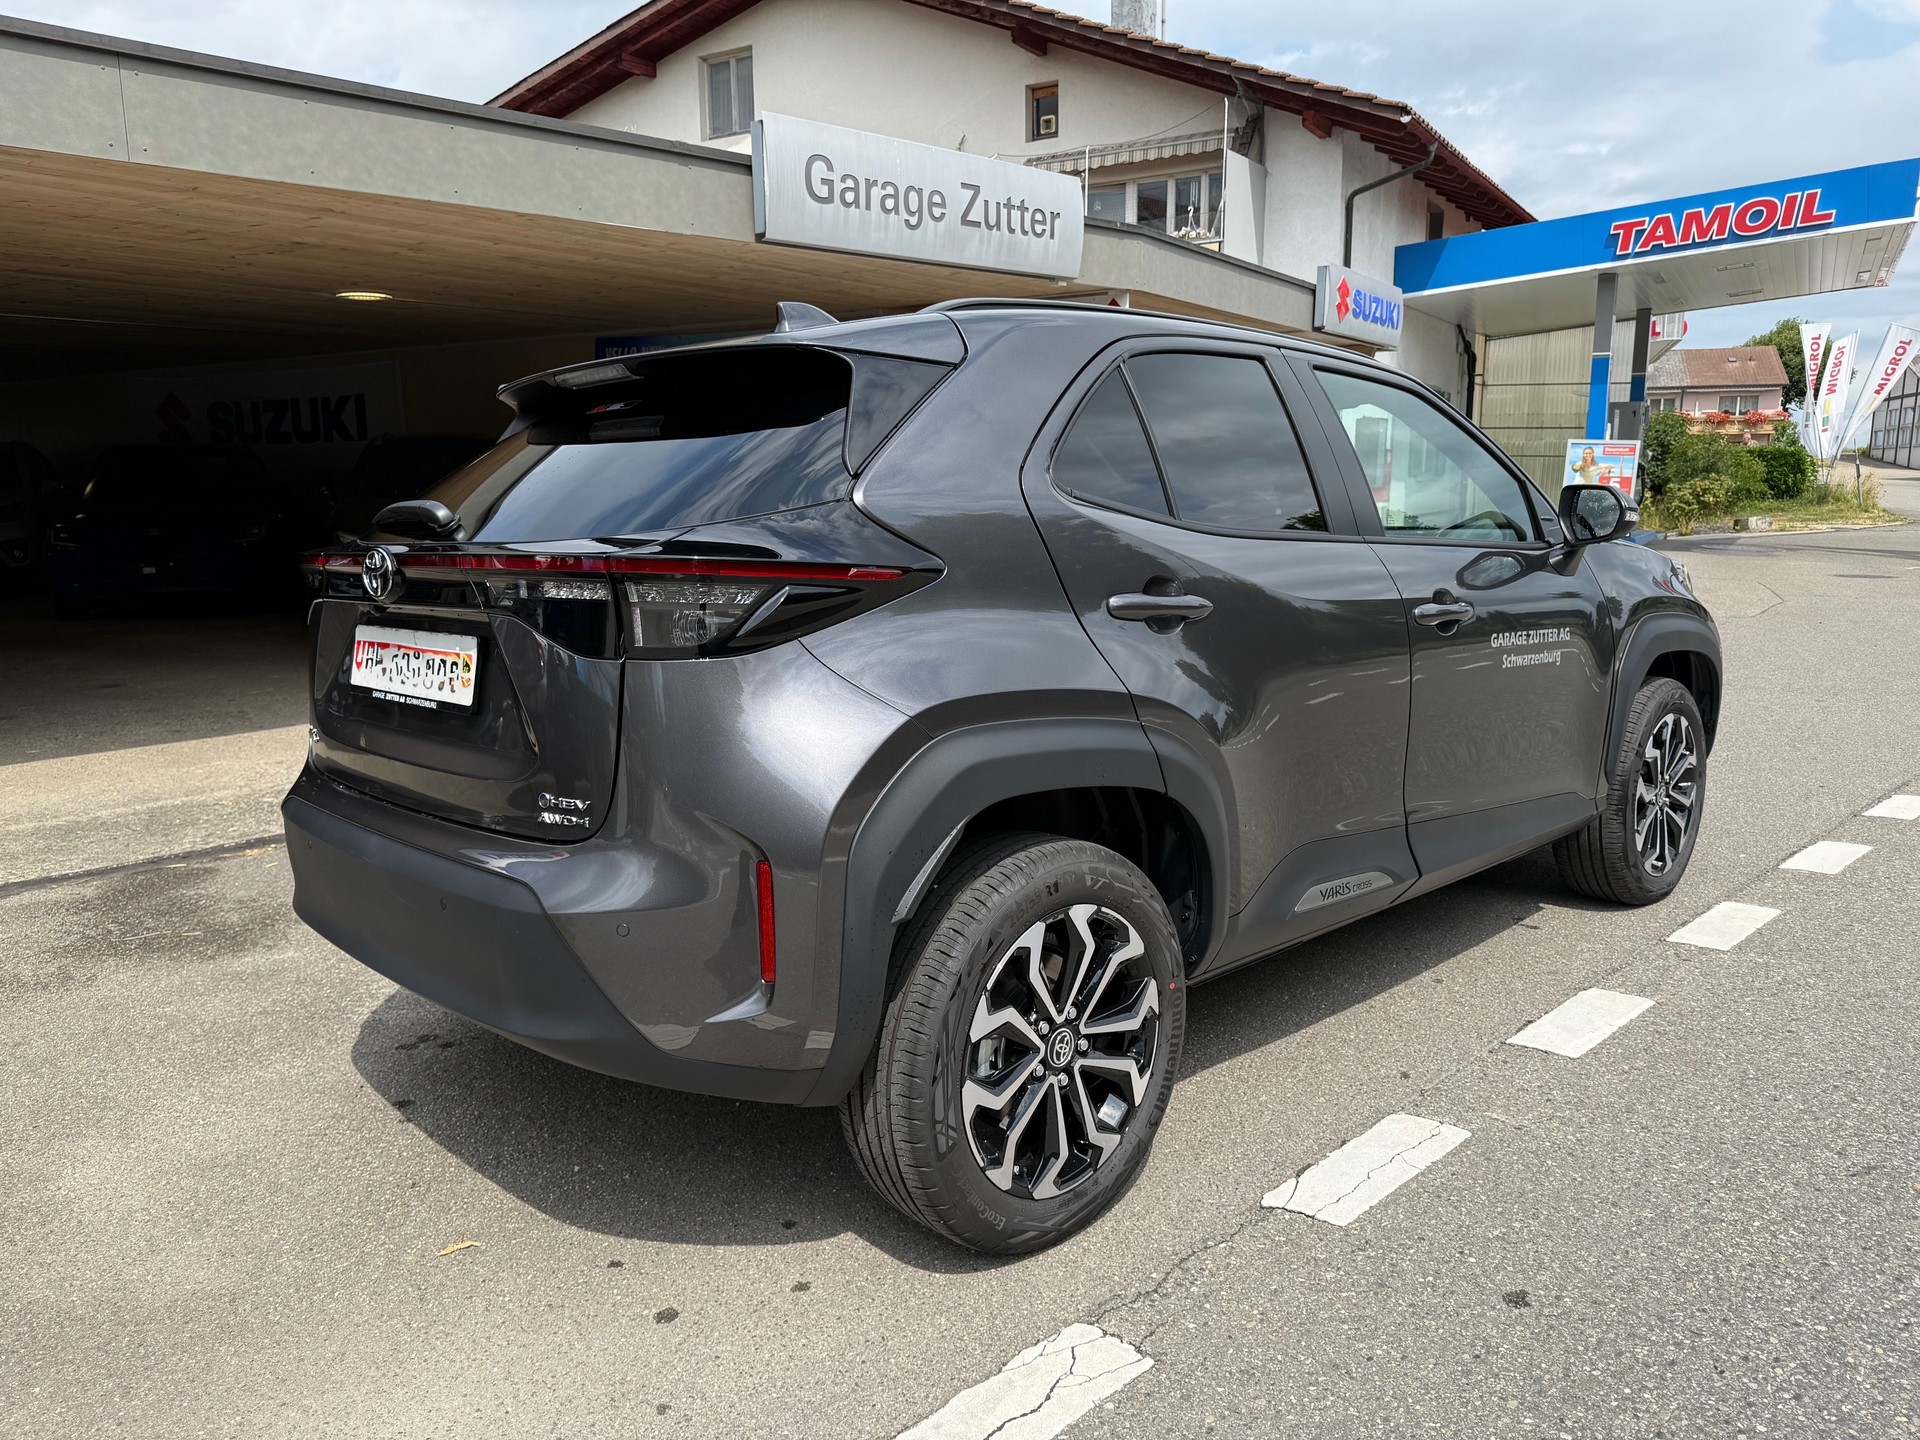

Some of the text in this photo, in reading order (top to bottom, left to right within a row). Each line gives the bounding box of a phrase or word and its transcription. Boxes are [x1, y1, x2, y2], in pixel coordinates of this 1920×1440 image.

[804, 153, 1061, 240] Garage Zutter
[1610, 189, 1837, 256] TAMOIL
[1352, 288, 1400, 330] SUZUKI
[1873, 338, 1914, 396] MIGROL
[206, 394, 369, 443] SUZUKI
[1490, 627, 1571, 648] GARAGE ZUTTER AG
[1502, 650, 1561, 669] Schwarzenburg
[1352, 880, 1373, 892] CROSS
